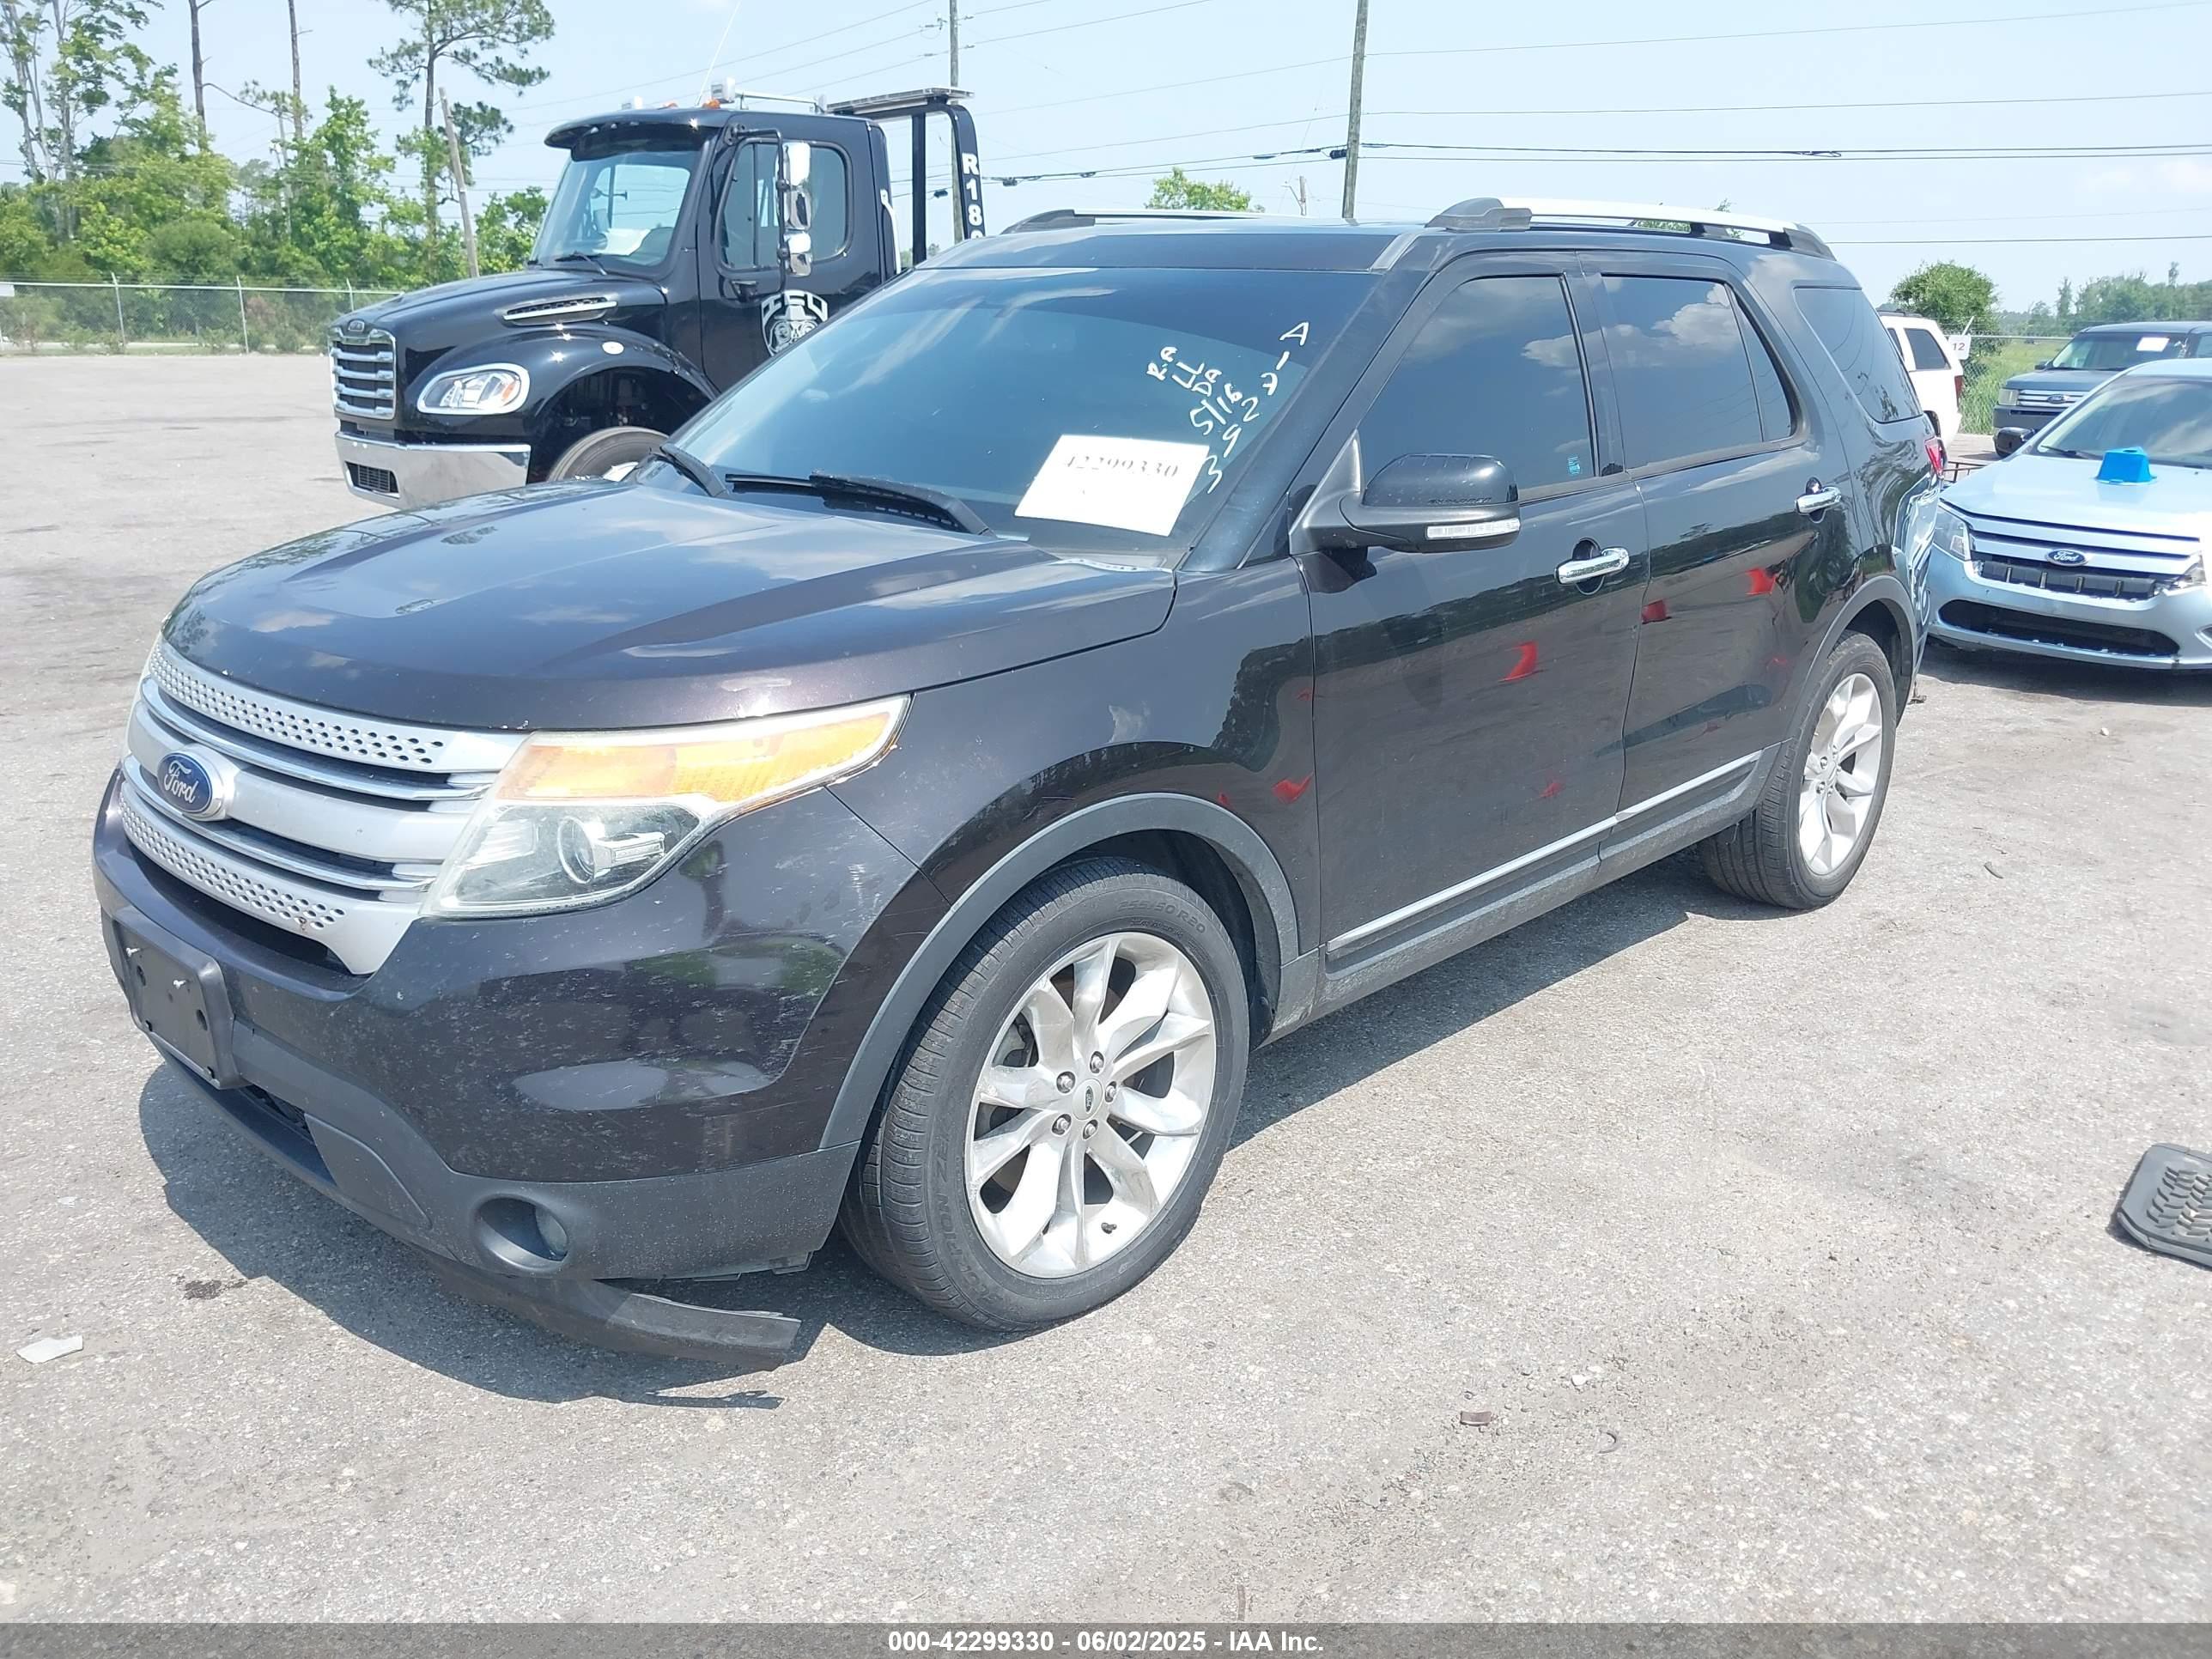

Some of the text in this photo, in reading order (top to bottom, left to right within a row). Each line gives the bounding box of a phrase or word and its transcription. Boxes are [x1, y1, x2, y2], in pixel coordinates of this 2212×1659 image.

[1953, 343, 1966, 351] 12
[2053, 550, 2080, 562] Ford
[164, 760, 199, 803] Ford
